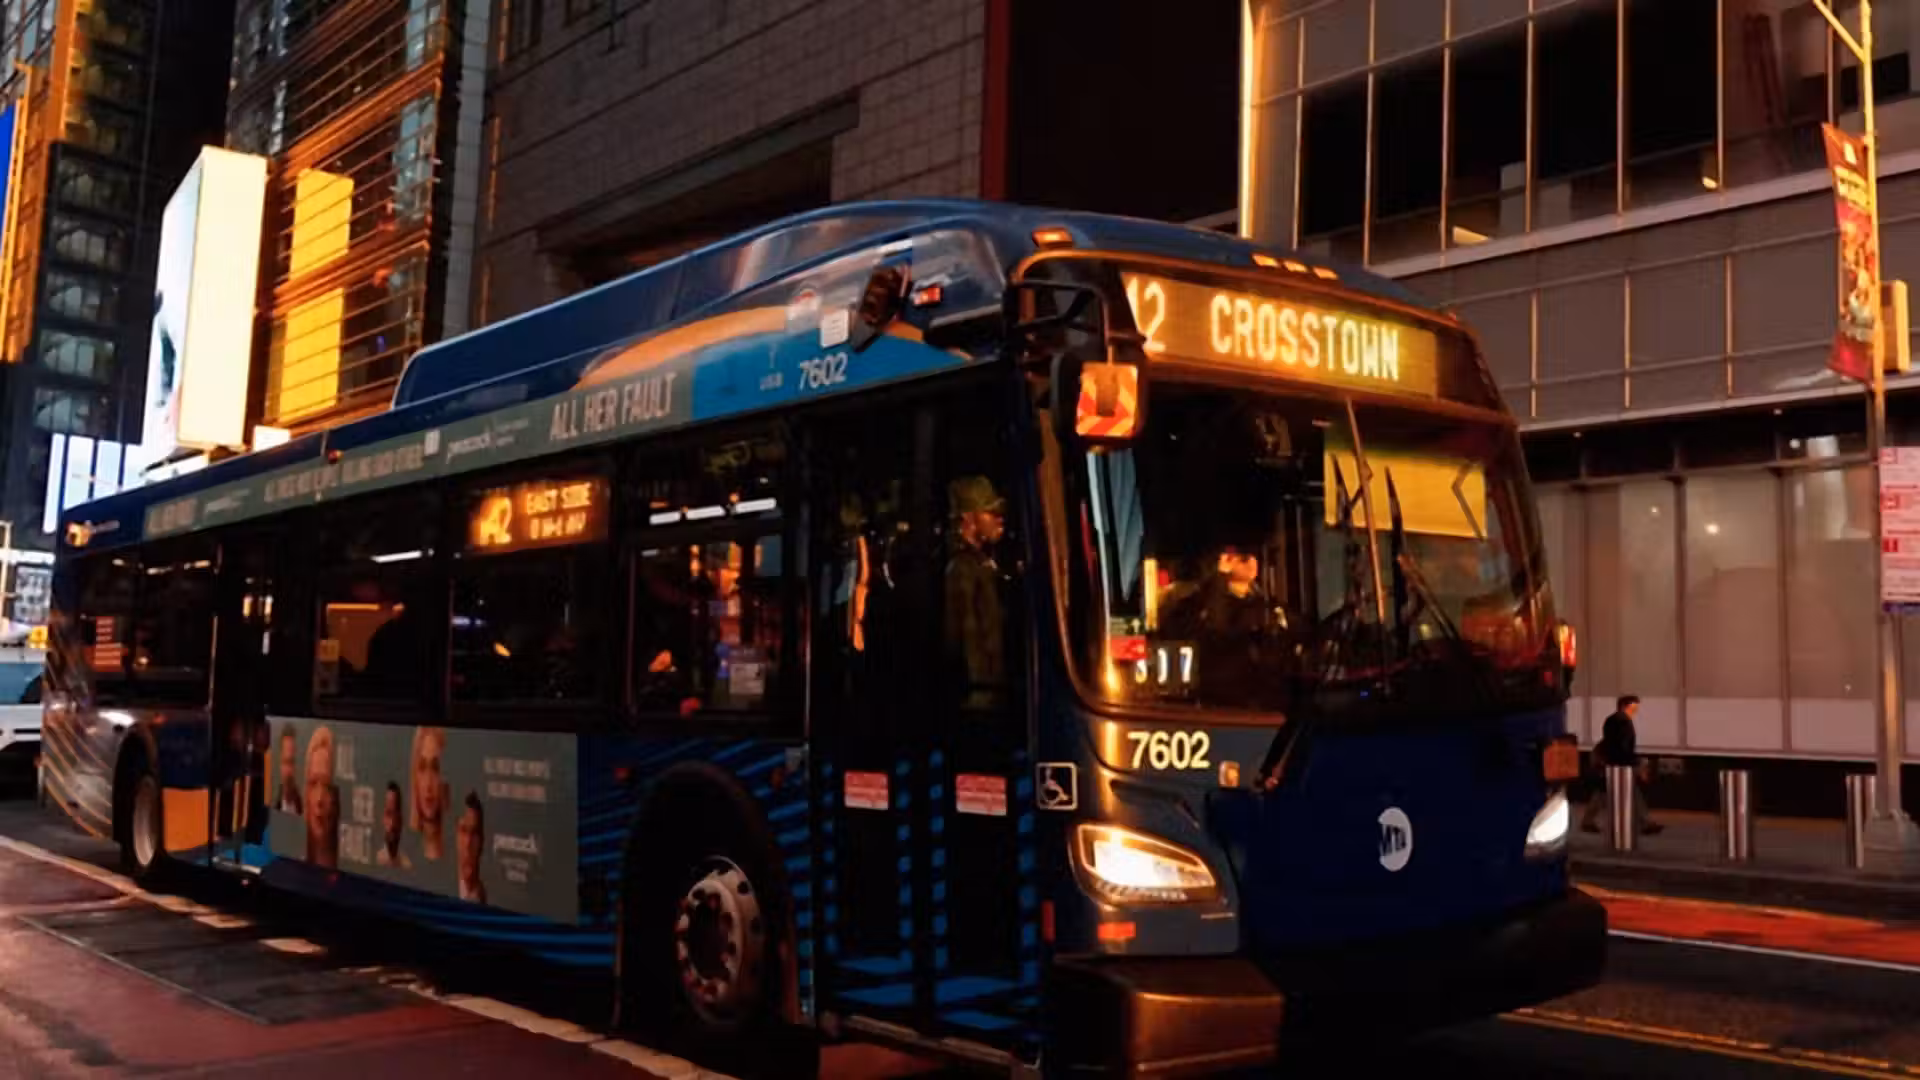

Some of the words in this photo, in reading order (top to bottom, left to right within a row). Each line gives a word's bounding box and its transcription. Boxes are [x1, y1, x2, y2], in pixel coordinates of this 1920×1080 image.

[1210, 293, 1399, 382] CROSSTOWN
[799, 351, 848, 391] 7602
[551, 399, 577, 441] ALL
[584, 388, 618, 433] HER
[622, 371, 677, 425] FAULT
[526, 489, 558, 515] EAST
[1127, 730, 1211, 770] 7602
